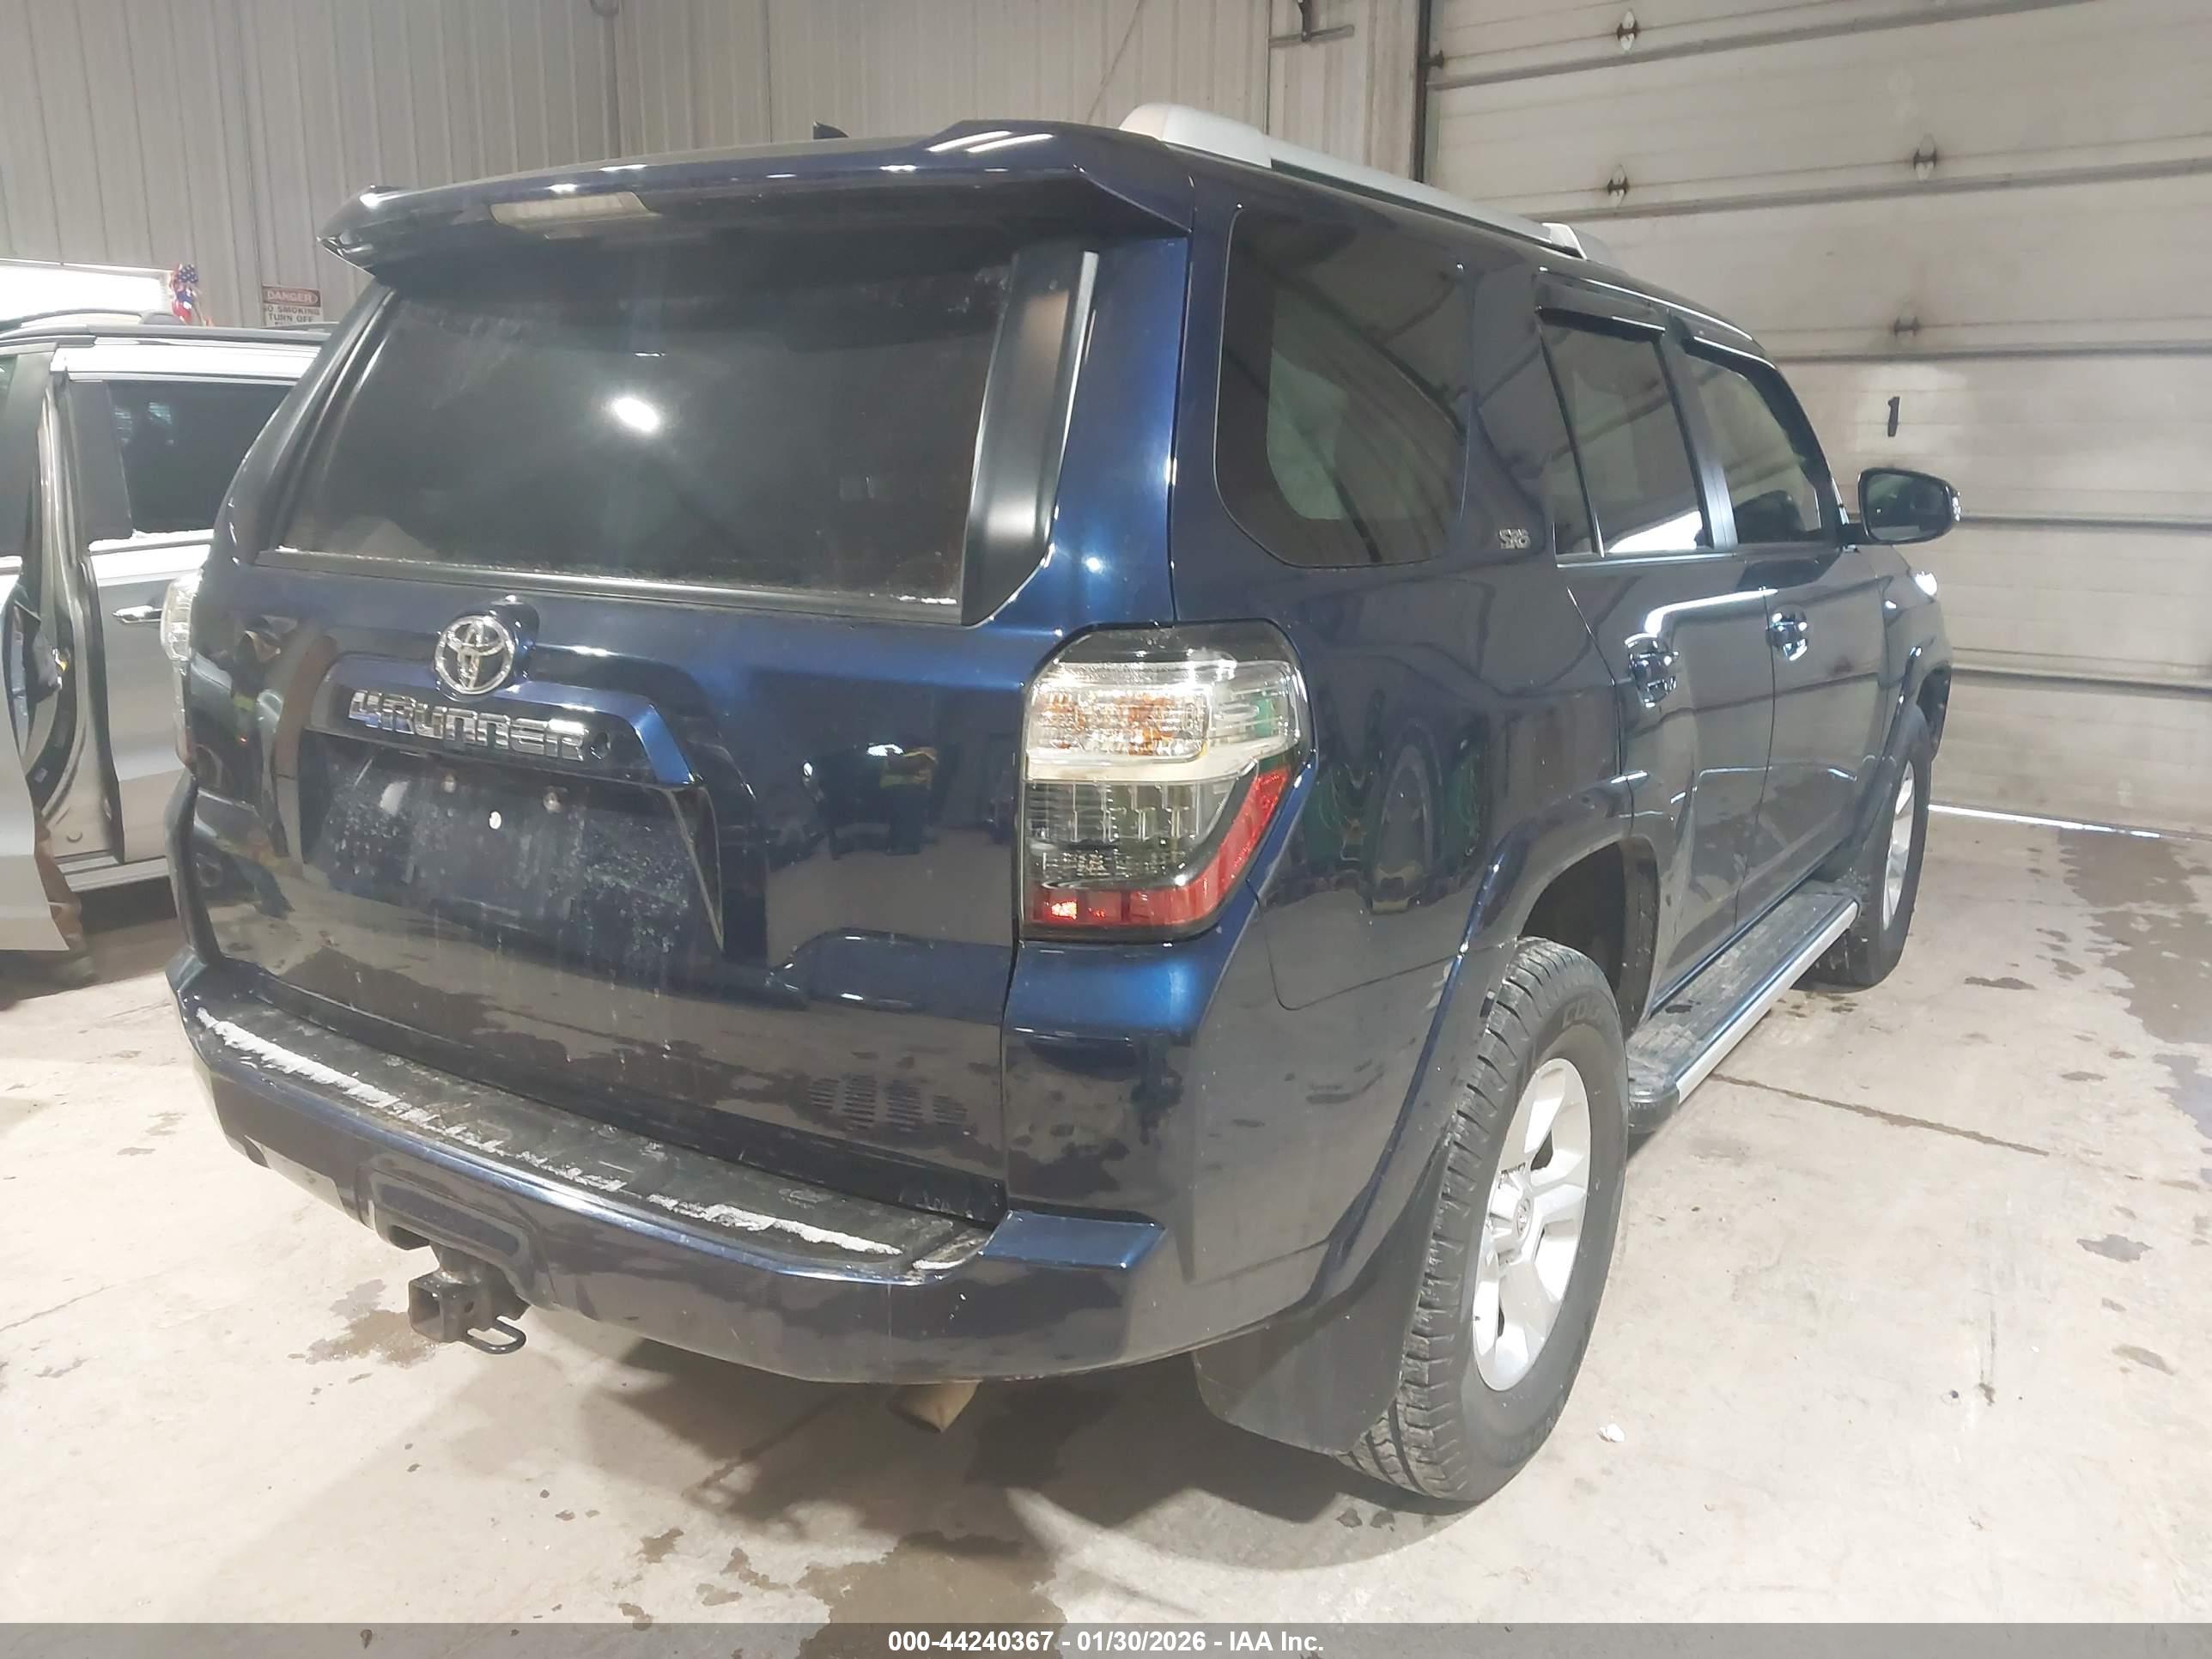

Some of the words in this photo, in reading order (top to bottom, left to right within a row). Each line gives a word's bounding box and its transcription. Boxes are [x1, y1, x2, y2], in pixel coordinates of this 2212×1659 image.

[267, 290, 313, 303] DANGER
[277, 305, 320, 316] SMOKING
[268, 313, 293, 322] TURN
[1887, 396, 1900, 438] 1
